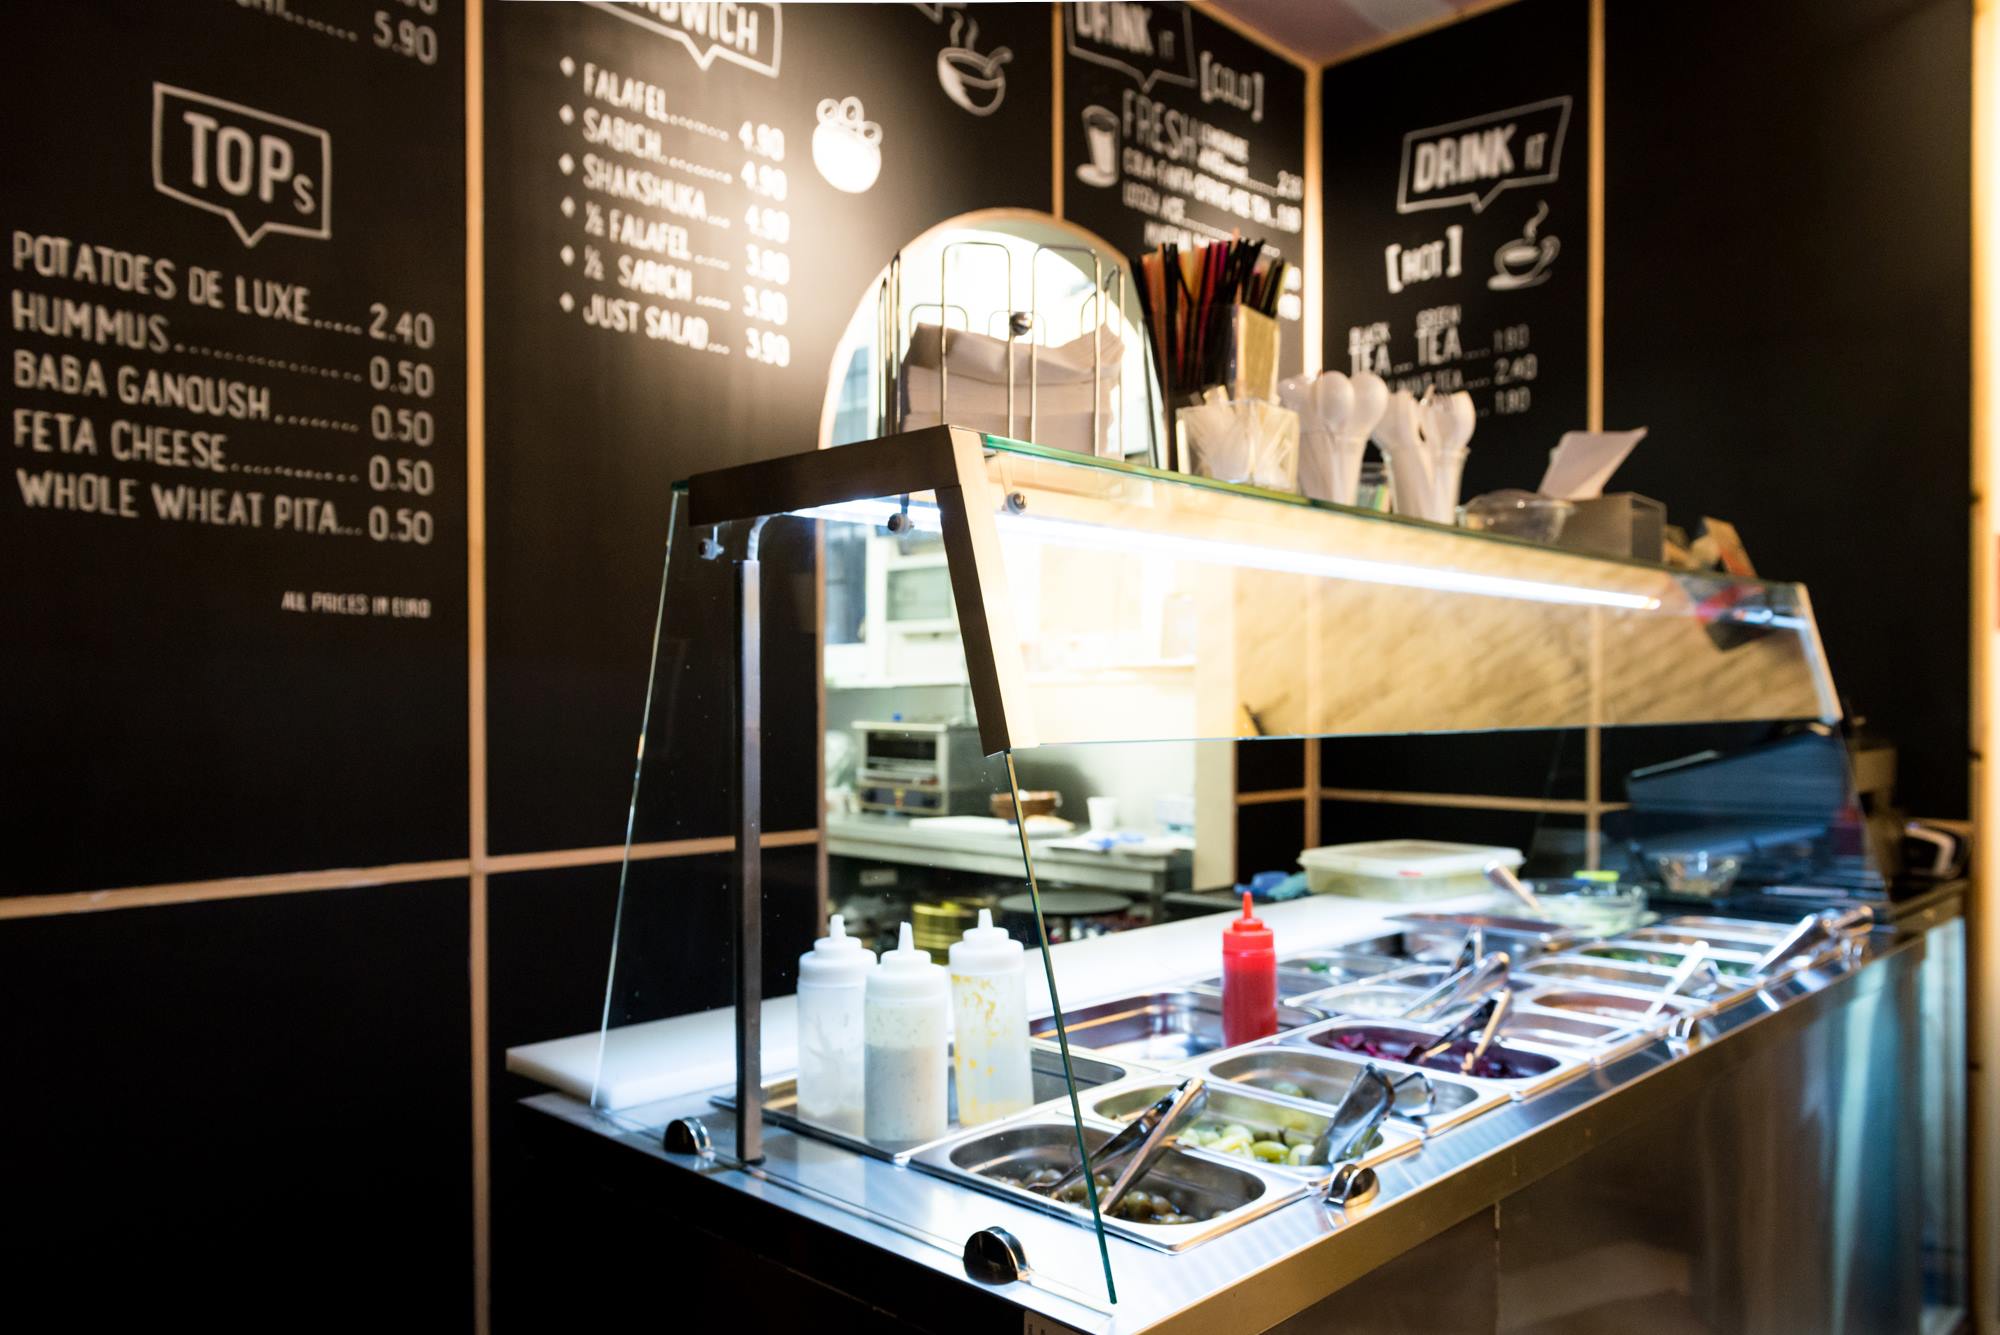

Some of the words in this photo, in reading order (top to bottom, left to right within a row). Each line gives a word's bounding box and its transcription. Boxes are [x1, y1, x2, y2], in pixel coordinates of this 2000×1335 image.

[373, 10, 438, 65] 5.90
[584, 62, 668, 123] FALAFEL
[1123, 88, 1198, 165] FRESH
[583, 107, 662, 159] SABICH
[1412, 122, 1519, 193] DRINK
[583, 153, 708, 221] SHAKSHUKA
[610, 208, 692, 262] FALAFEL
[13, 230, 176, 299] POTATOES
[188, 266, 225, 309] DE
[369, 303, 435, 349] 2.40
[617, 254, 693, 302] SABICH
[12, 289, 171, 354] HUMMUS
[369, 356, 435, 398] 0.50
[583, 294, 640, 333] JUST
[645, 305, 709, 350] SALAD
[13, 349, 108, 399] BABA
[117, 364, 270, 421] GANOUSH
[370, 405, 435, 447] 0.50
[13, 408, 98, 456] FETA
[110, 420, 228, 473] CHEESE
[369, 455, 435, 496] 0.50
[16, 468, 141, 519] WHOLE
[150, 482, 265, 527] WHEAT
[274, 494, 338, 535] PITA
[368, 506, 434, 545] 0.50
[281, 590, 306, 613] ALL
[311, 592, 369, 616] PRICES
[372, 595, 389, 617] IN
[391, 596, 432, 619] EURO
